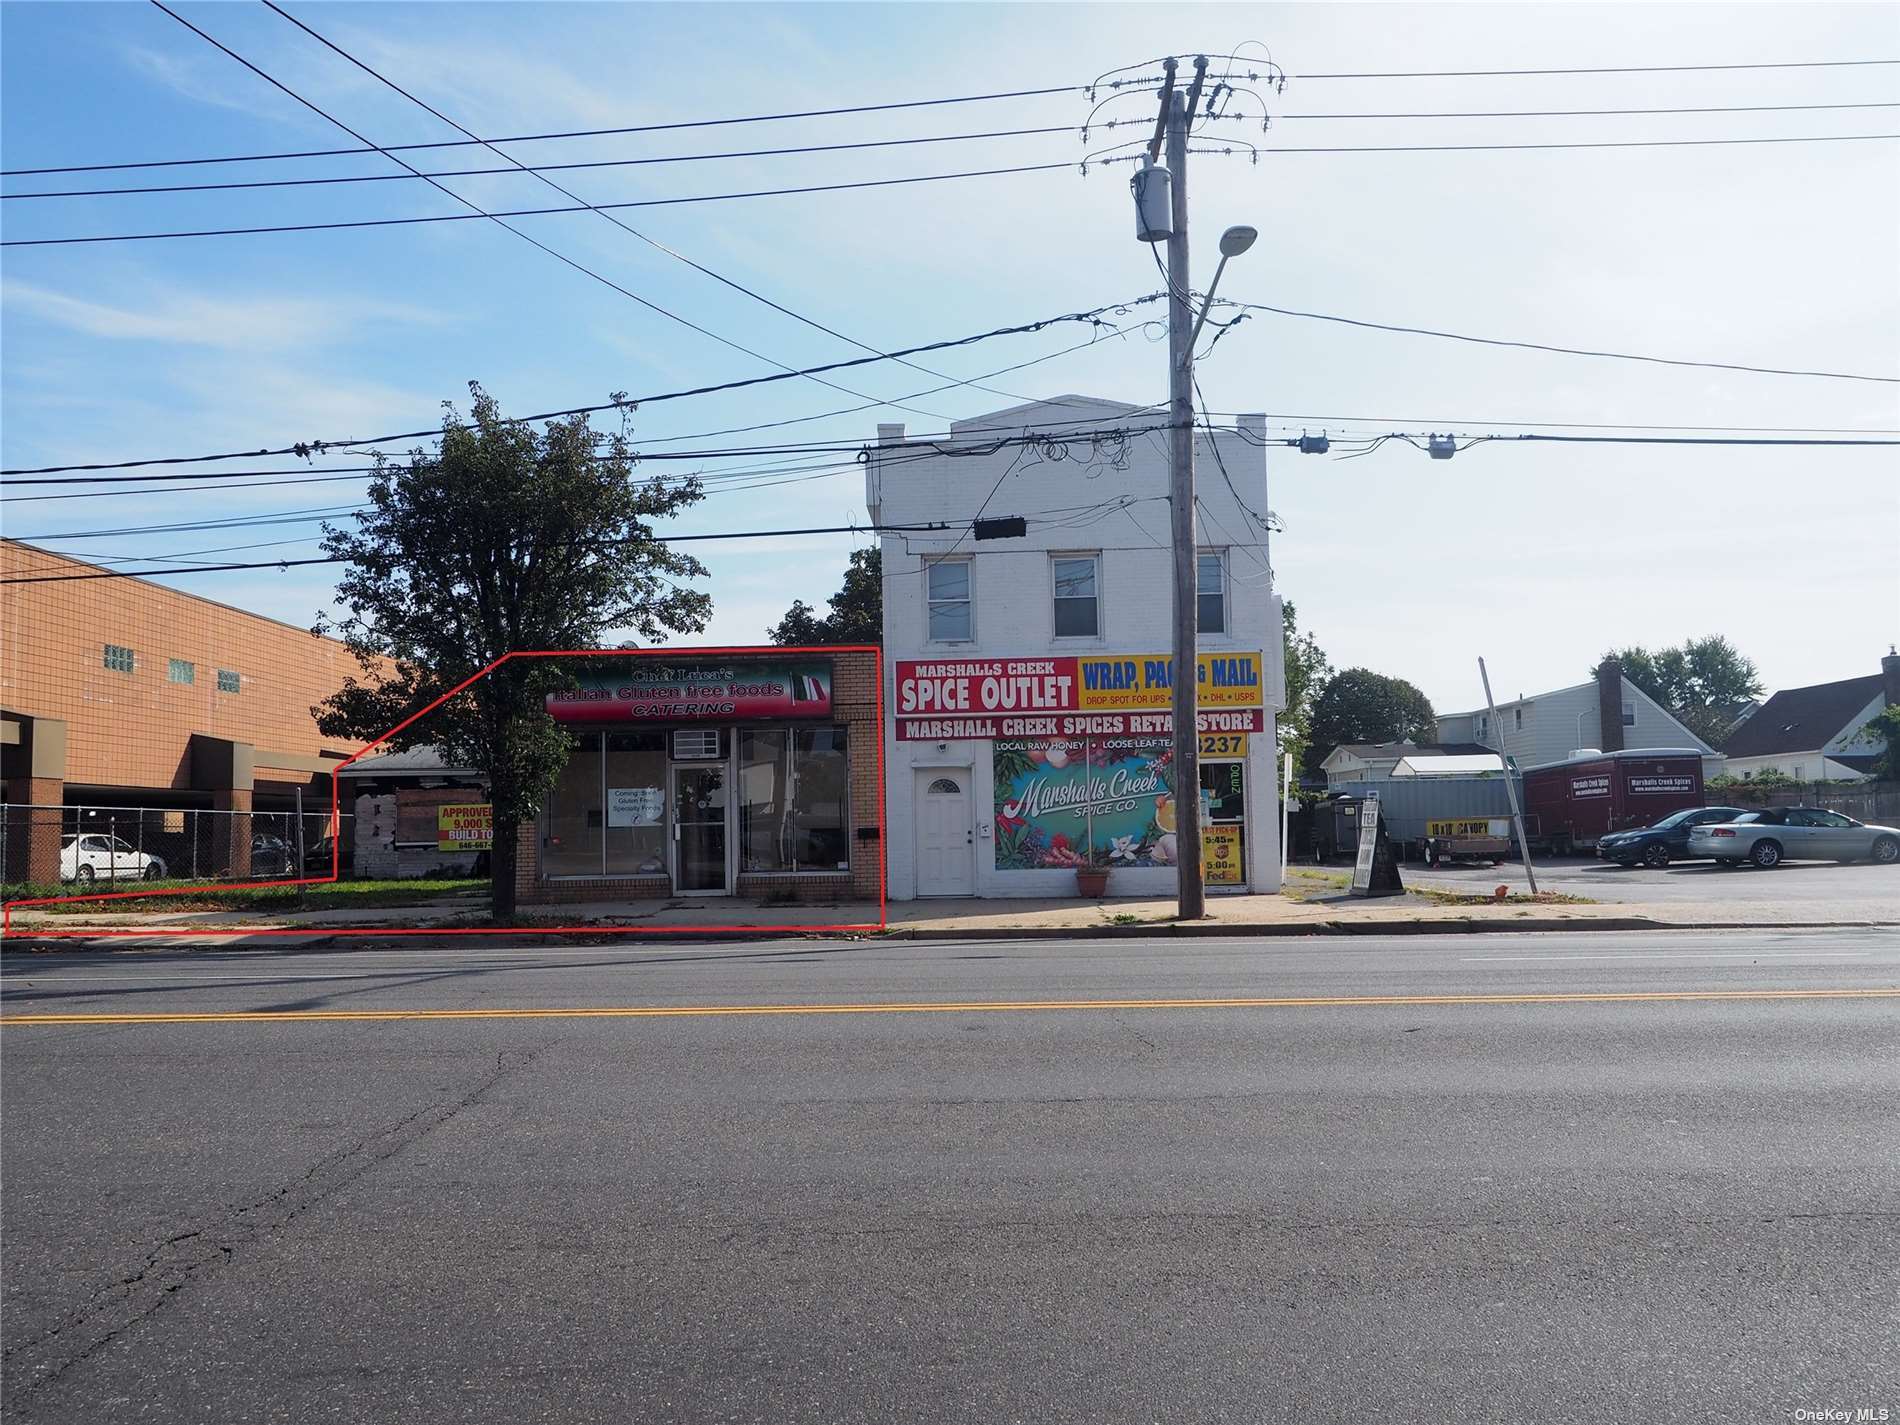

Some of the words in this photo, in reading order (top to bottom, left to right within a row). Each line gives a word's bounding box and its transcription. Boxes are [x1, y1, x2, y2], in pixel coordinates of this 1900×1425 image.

[677, 667, 734, 681] Luca's
[916, 663, 1002, 677] MARSHALLS
[1007, 662, 1055, 675] CREEK
[1082, 661, 1139, 692] WRAP,
[1144, 660, 1173, 688] PA
[1197, 664, 1206, 683] &
[1211, 658, 1258, 687] MAIL
[617, 684, 681, 699] Gluten
[686, 682, 724, 698] free
[727, 681, 784, 697] foods
[901, 679, 970, 711] SPICE
[981, 676, 1072, 710] OUTLET
[1086, 696, 1108, 705] DROP
[1111, 695, 1129, 704] SPOT
[1132, 695, 1148, 704] FOR
[1150, 694, 1166, 704] UPS
[1211, 693, 1226, 702] DHL
[1234, 692, 1255, 701] USPS
[632, 702, 735, 717] CATERING
[906, 720, 997, 738] MARSHALL
[1003, 718, 1058, 736] CREEK
[1063, 715, 1123, 734] SPICES
[1130, 715, 1173, 733] RETA
[1196, 713, 1253, 731] STORE
[996, 742, 1025, 751] LOCAL
[1028, 742, 1048, 750] RAW
[1050, 741, 1085, 750] HONEY
[1102, 740, 1133, 748] LOOSE
[1135, 739, 1157, 748] LEAF
[1003, 775, 1107, 818] Marshalls
[1109, 768, 1159, 798] Creek
[1074, 803, 1112, 818] SPICE
[1116, 800, 1138, 815] CO.
[448, 830, 478, 840] BUILD
[481, 830, 493, 840] TO
